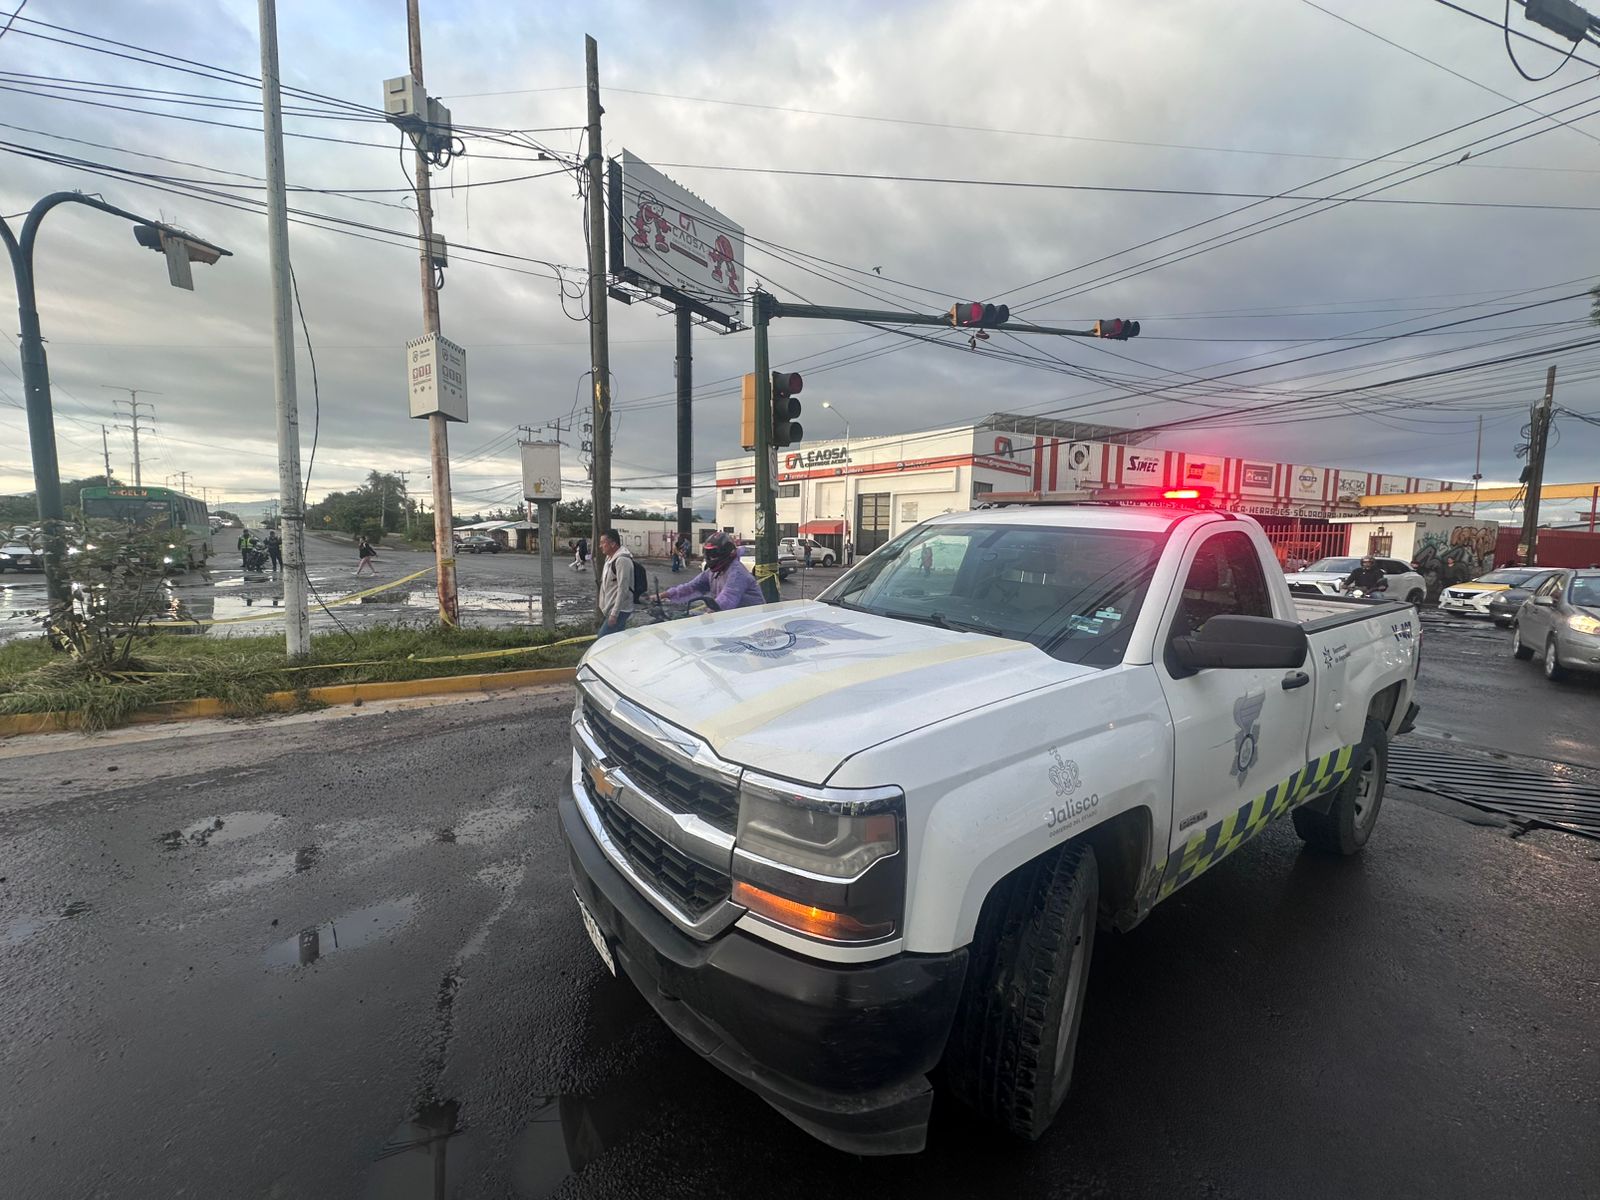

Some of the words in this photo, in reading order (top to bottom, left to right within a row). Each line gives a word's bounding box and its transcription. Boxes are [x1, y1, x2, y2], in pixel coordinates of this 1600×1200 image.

[807, 447, 847, 462] CAOSA
[1127, 456, 1158, 472] SIMEC
[1249, 505, 1290, 516] HERRAJES
[1294, 509, 1336, 519] SOLDADURA
[1047, 793, 1099, 828] Jalisco
